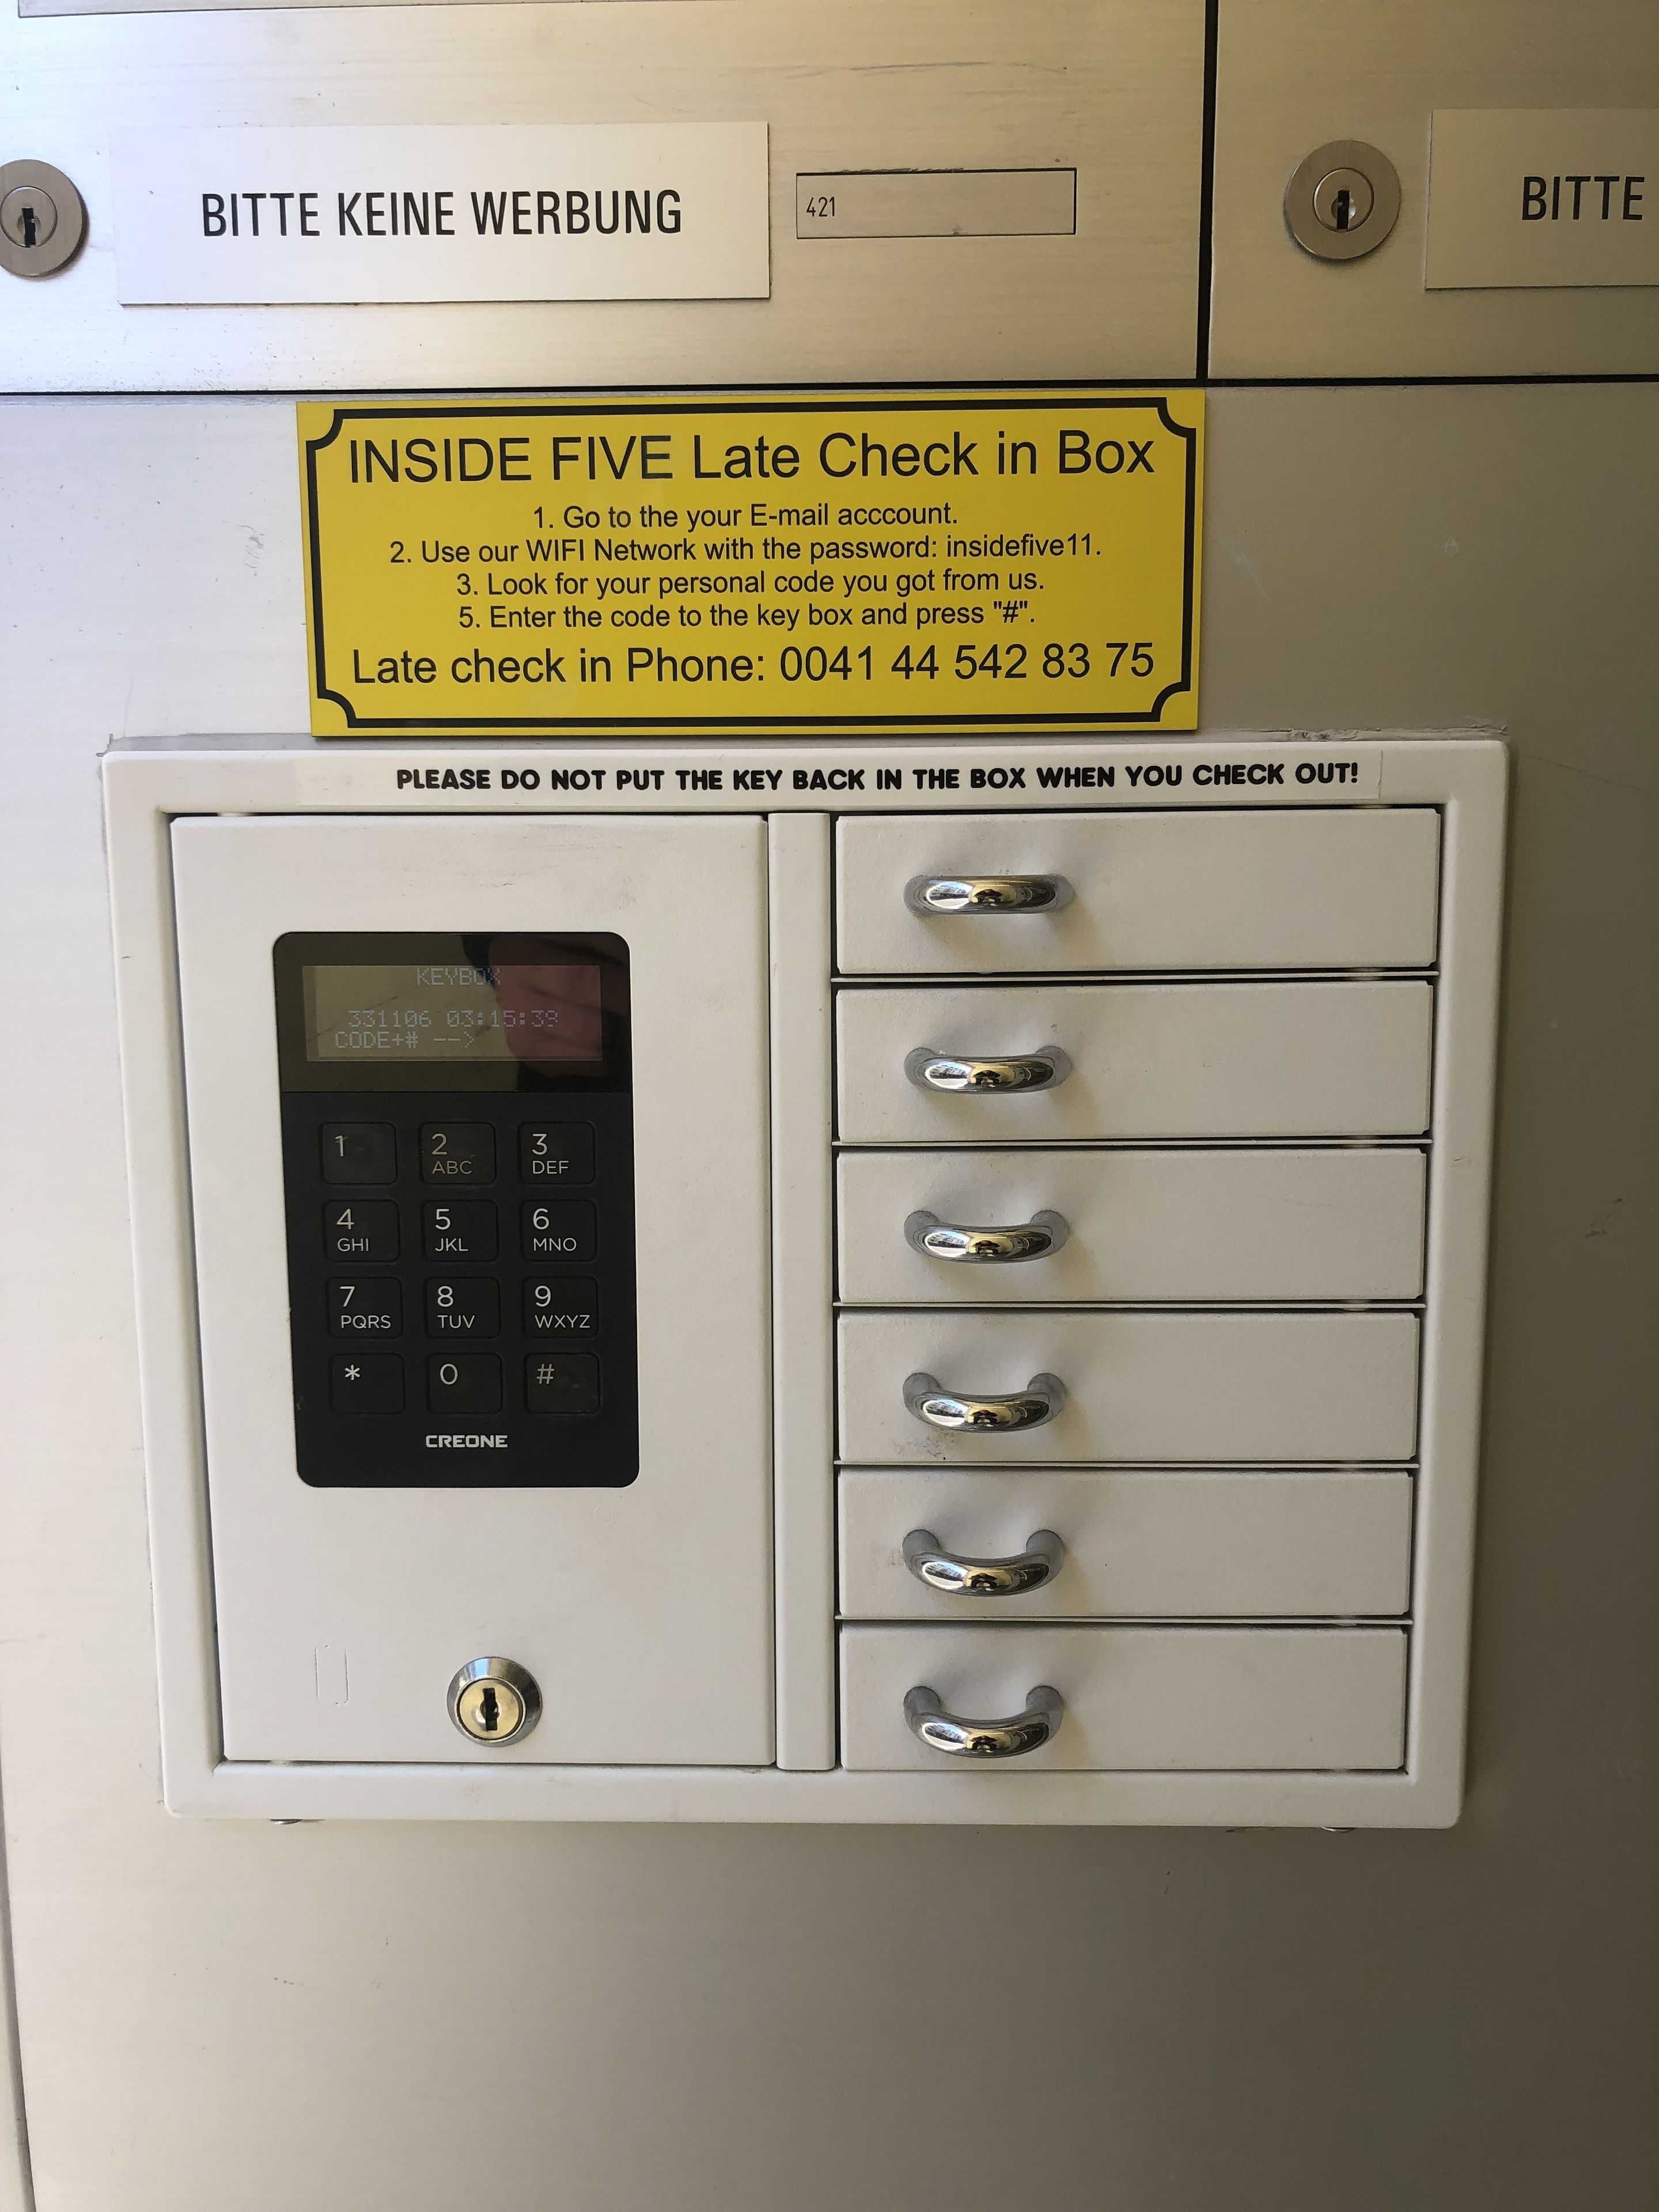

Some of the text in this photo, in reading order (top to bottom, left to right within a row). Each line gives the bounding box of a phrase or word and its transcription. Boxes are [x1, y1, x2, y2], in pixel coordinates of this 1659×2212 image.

[806, 197, 835, 217] 421
[1522, 176, 1645, 220] BITTE
[202, 190, 680, 236] BITTE KEINE WERBUNG
[351, 430, 1154, 483] INSIDE FIVE Late Check in Box
[535, 502, 957, 532] 1. Go to the your E-mail acccount.
[391, 533, 1100, 565] 2. Use our WIFI Network with the password: insidefive11.
[457, 569, 1043, 600] 3. Look for your personal code you got from us.
[460, 600, 1034, 631] 5. Enter the code to the key box and press "#".
[354, 643, 1153, 683] Late check in Phone: 0041 44 542 83 75
[397, 763, 1358, 790] PLEASE DO NOT PUT THE KEY BACK IN THE BOX WHEN YOU CHECK OUT!
[416, 968, 501, 985] KEYBOX
[335, 1032, 418, 1048] CODE+#
[336, 1135, 343, 1156] 1
[433, 1134, 447, 1154] 2
[532, 1134, 547, 1154] 3
[433, 1161, 471, 1174] ABC
[533, 1161, 569, 1174] DEF
[337, 1209, 354, 1229] 4
[435, 1209, 450, 1229] 5
[533, 1209, 549, 1229] 6
[338, 1238, 368, 1251] GHI
[435, 1238, 468, 1251] JKL
[534, 1238, 576, 1251] MNO
[340, 1286, 355, 1306] 7
[438, 1286, 453, 1306] 8
[535, 1286, 551, 1306] 9
[341, 1315, 391, 1328] PQRS
[438, 1315, 475, 1328] TUV
[535, 1315, 590, 1328] WXYZ
[440, 1364, 457, 1384] 0
[426, 1435, 507, 1447] CREONE
